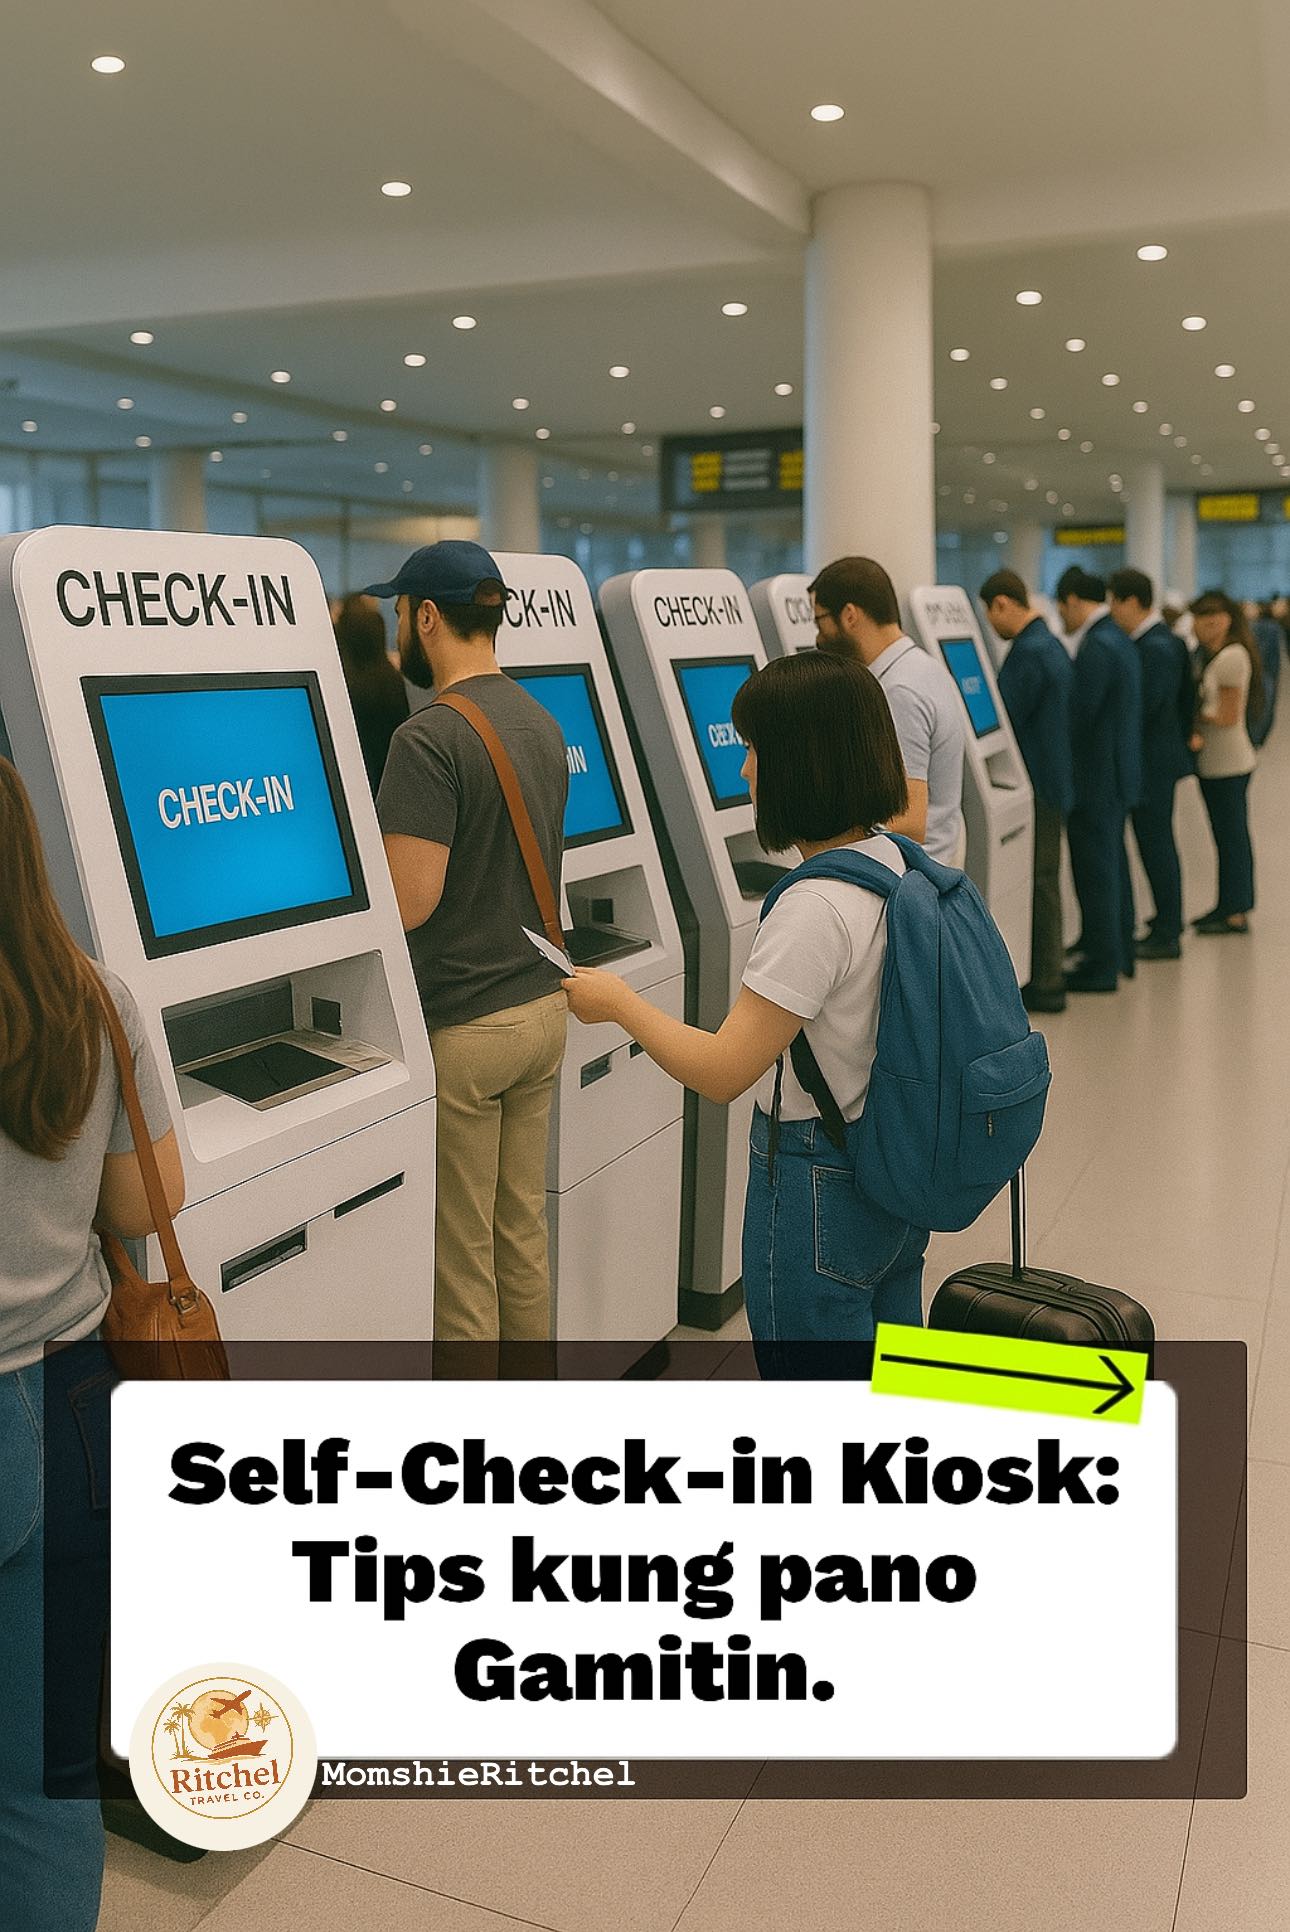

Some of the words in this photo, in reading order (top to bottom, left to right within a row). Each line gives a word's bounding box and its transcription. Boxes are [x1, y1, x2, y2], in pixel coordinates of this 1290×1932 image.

[56, 569, 297, 627] CHECK-IN
[504, 588, 577, 628] CK-IN
[654, 596, 743, 627] CHECK-IN
[158, 774, 295, 829] CHECK-IN
